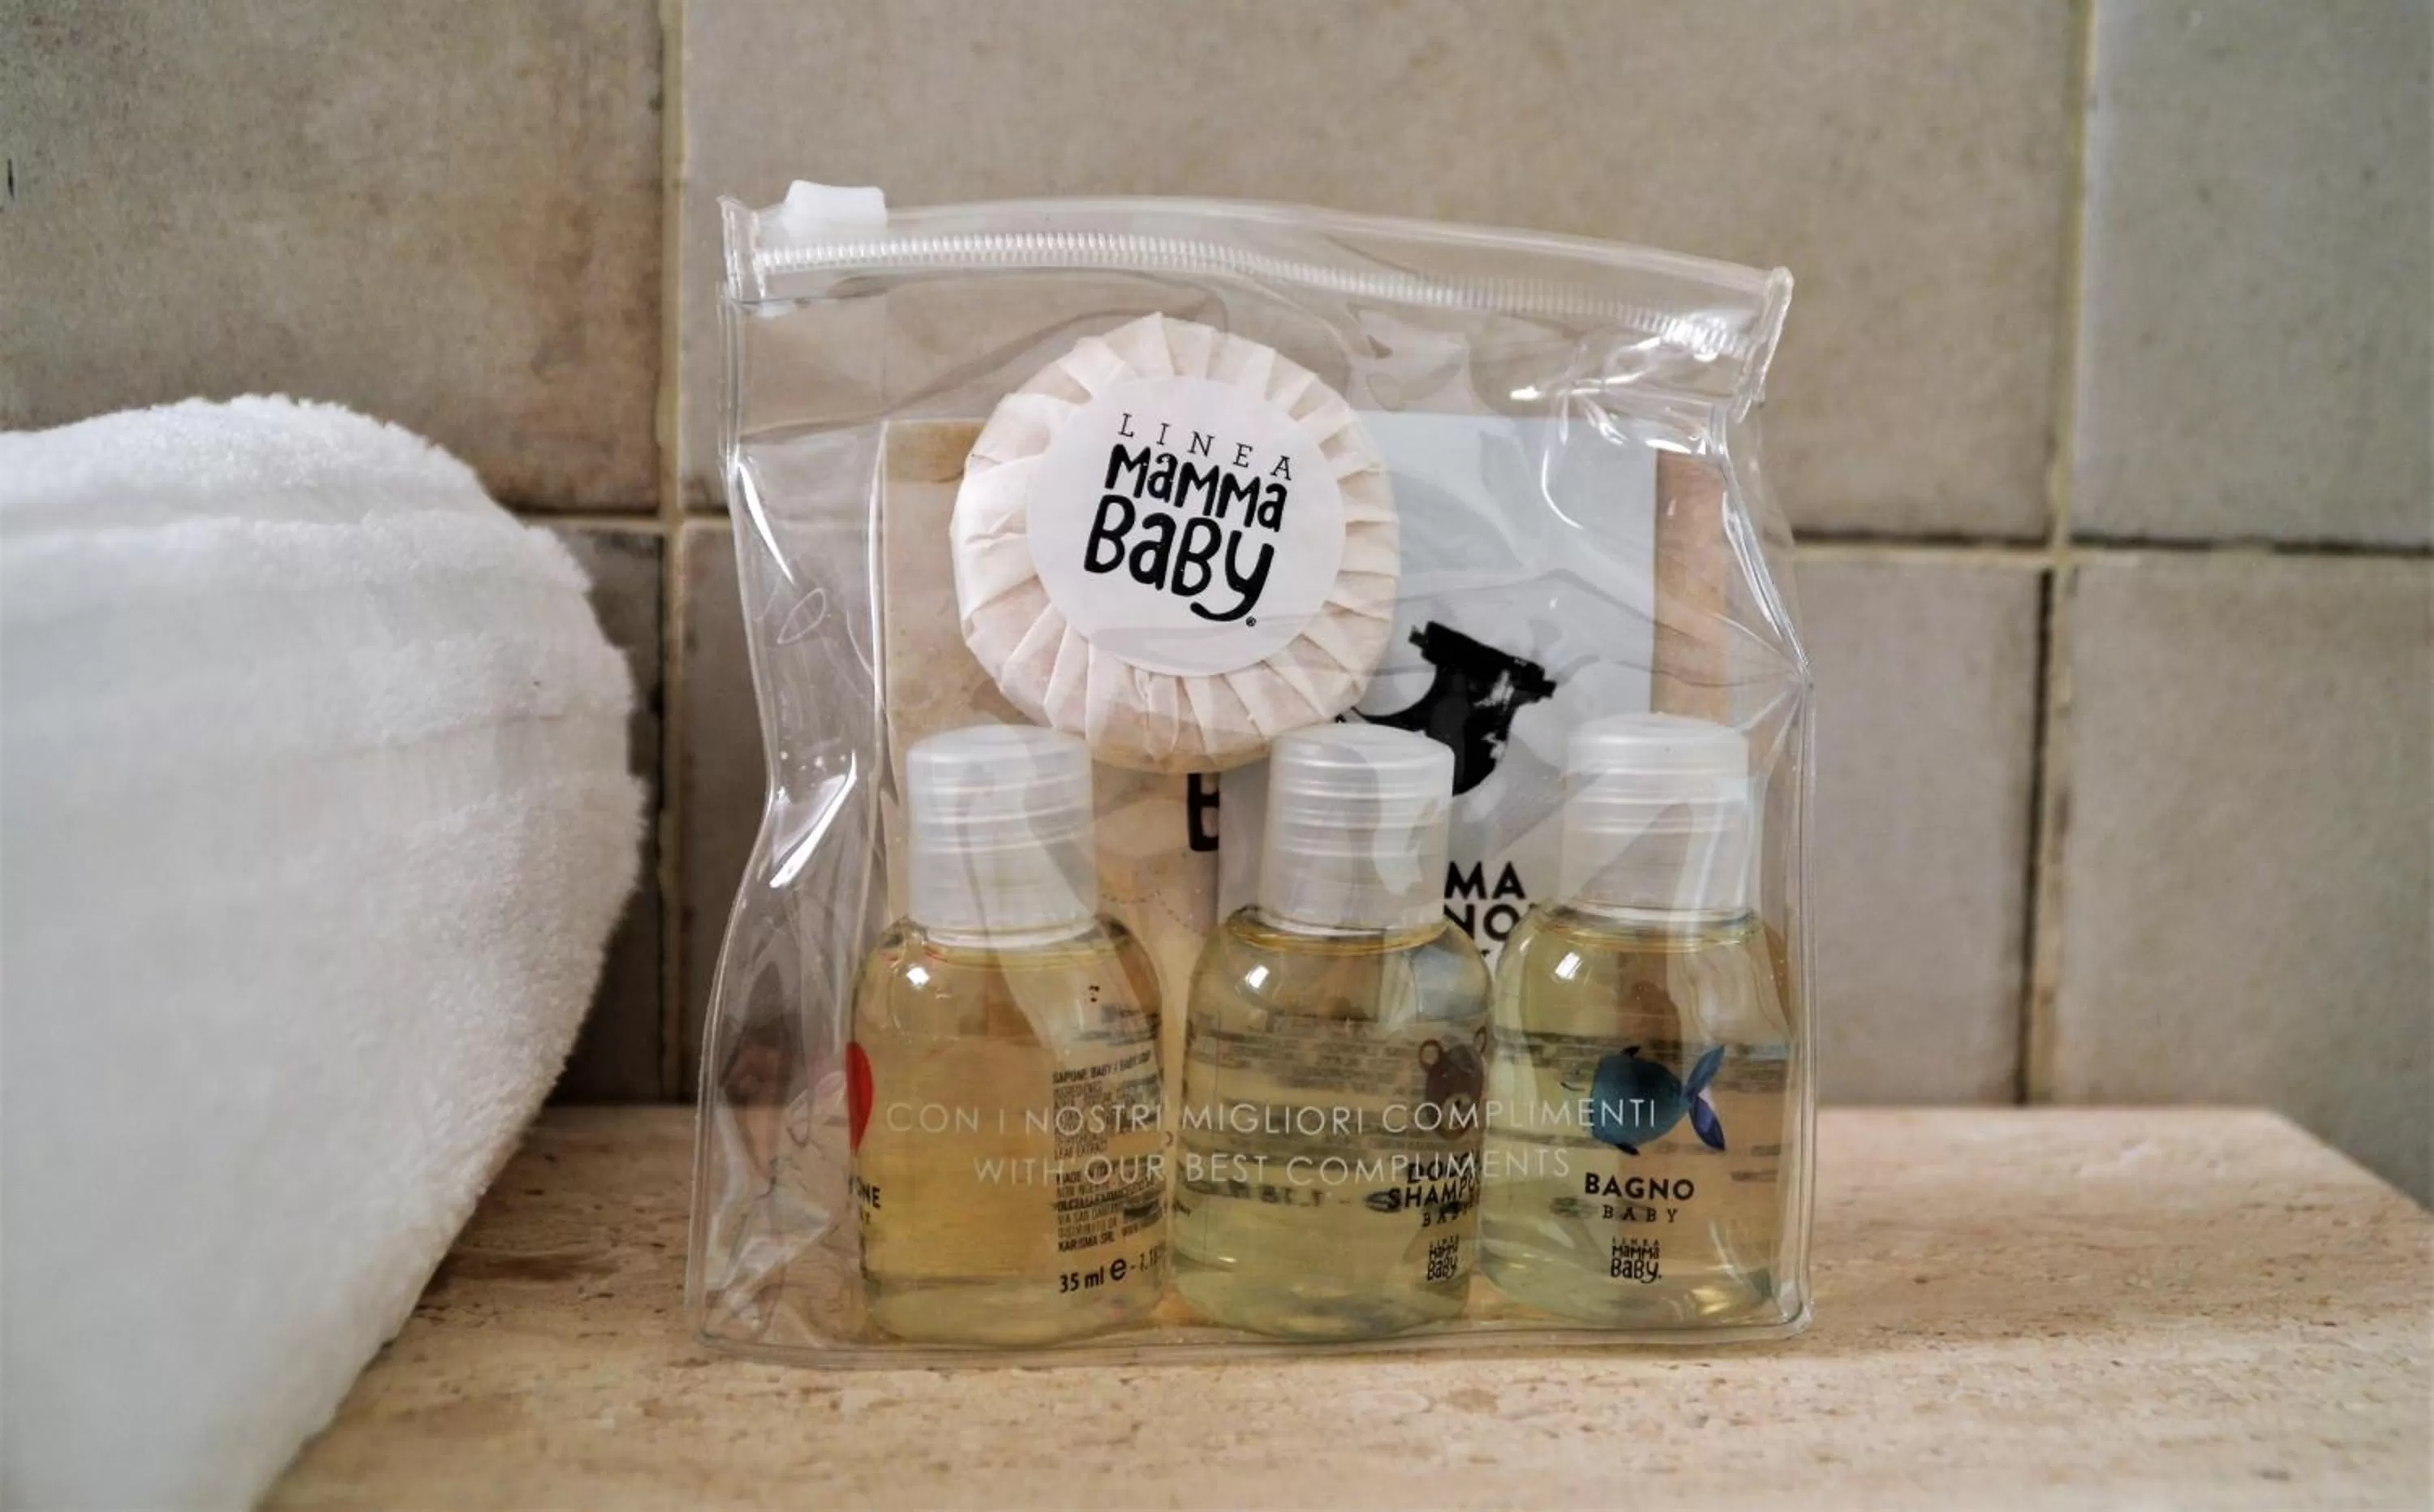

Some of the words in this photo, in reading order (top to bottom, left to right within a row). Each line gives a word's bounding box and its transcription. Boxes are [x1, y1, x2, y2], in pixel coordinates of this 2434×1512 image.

[1117, 412, 1292, 482] LINEA
[1443, 859, 1528, 901] MA
[885, 1102, 978, 1134] CON
[999, 1103, 1005, 1132] I
[1025, 1103, 1163, 1136] NOSTRI
[1181, 1102, 1363, 1136] MIGLIORI
[1382, 1097, 1656, 1134] COMPLIMENTI
[974, 1156, 1064, 1187] WITH
[1083, 1153, 1166, 1185] OUR
[1186, 1153, 1269, 1183] BEST
[1285, 1150, 1570, 1187] COMPLIMENTS
[1585, 1171, 1695, 1201] BAGNO
[1602, 1204, 1679, 1223] BABY
[1059, 1271, 1080, 1294] 35
[1083, 1265, 1105, 1290] ml
